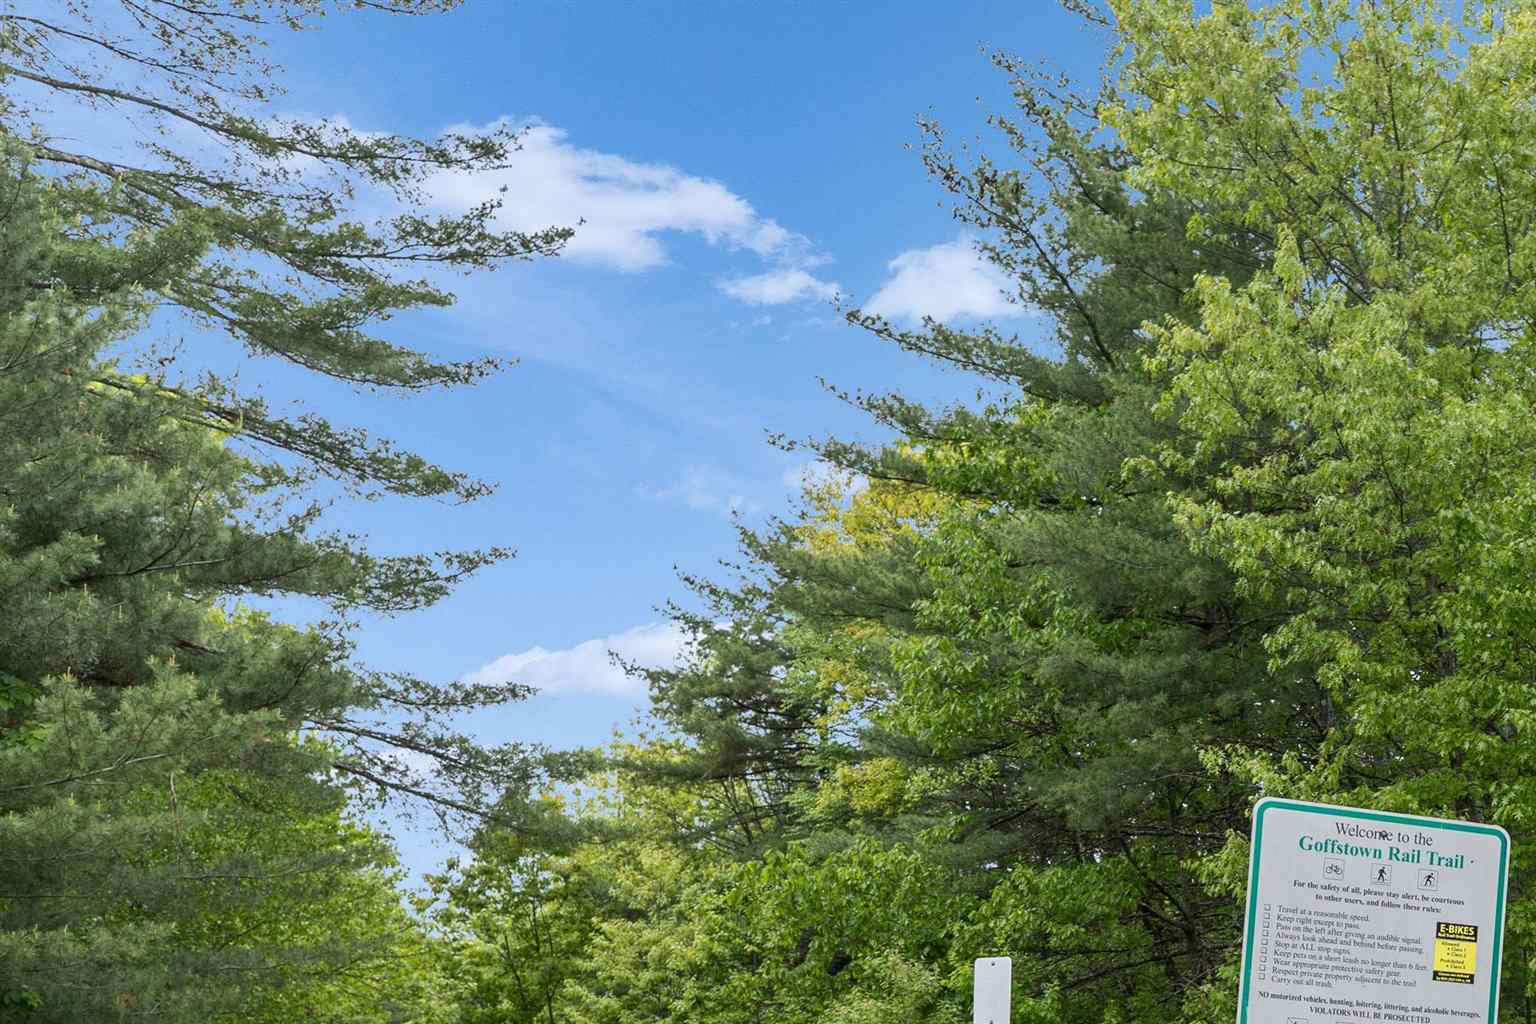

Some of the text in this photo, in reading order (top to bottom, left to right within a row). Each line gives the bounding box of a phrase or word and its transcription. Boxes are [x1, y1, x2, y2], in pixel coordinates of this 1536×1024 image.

[1335, 821, 1433, 847] Welcome to the
[1298, 835, 1464, 869] Goffstown Rail Trail
[1293, 879, 1306, 888] For
[1307, 881, 1318, 889] the
[1320, 882, 1340, 894] safety
[1363, 888, 1384, 898] please
[1386, 891, 1400, 900] stay
[1431, 896, 1465, 906] courteous
[1324, 895, 1342, 903] other
[1366, 899, 1380, 907] and
[1381, 900, 1401, 909] follow
[1403, 904, 1420, 912] these
[1277, 905, 1298, 915] Travel
[1314, 909, 1348, 920] reasonable
[1276, 914, 1294, 924] Keep
[1295, 916, 1312, 926] right
[1313, 919, 1335, 928] except
[1276, 923, 1292, 932] Pass
[1302, 926, 1314, 934] the
[1315, 927, 1326, 935] left
[1327, 928, 1343, 937] after
[1440, 923, 1475, 936] E-BIKES
[1275, 931, 1300, 942] Always
[1302, 934, 1316, 942] look
[1318, 936, 1338, 944] ahead
[1340, 938, 1352, 946] and
[1353, 940, 1376, 949] behind
[1274, 941, 1290, 950] Stop
[1299, 943, 1316, 951] ALL
[1317, 946, 1332, 954] stop
[1274, 949, 1292, 958] Keep
[1293, 952, 1307, 960] pets
[1273, 958, 1290, 966] Wear
[1272, 966, 1298, 977] Respect
[1271, 976, 1292, 986] Carry
[1271, 992, 1302, 1001] motorized
[1411, 1005, 1423, 1013] and
[1424, 1006, 1449, 1015] alcoholic
[1309, 1006, 1431, 1024] VIOLATORS WILL BE PROSECUTED
